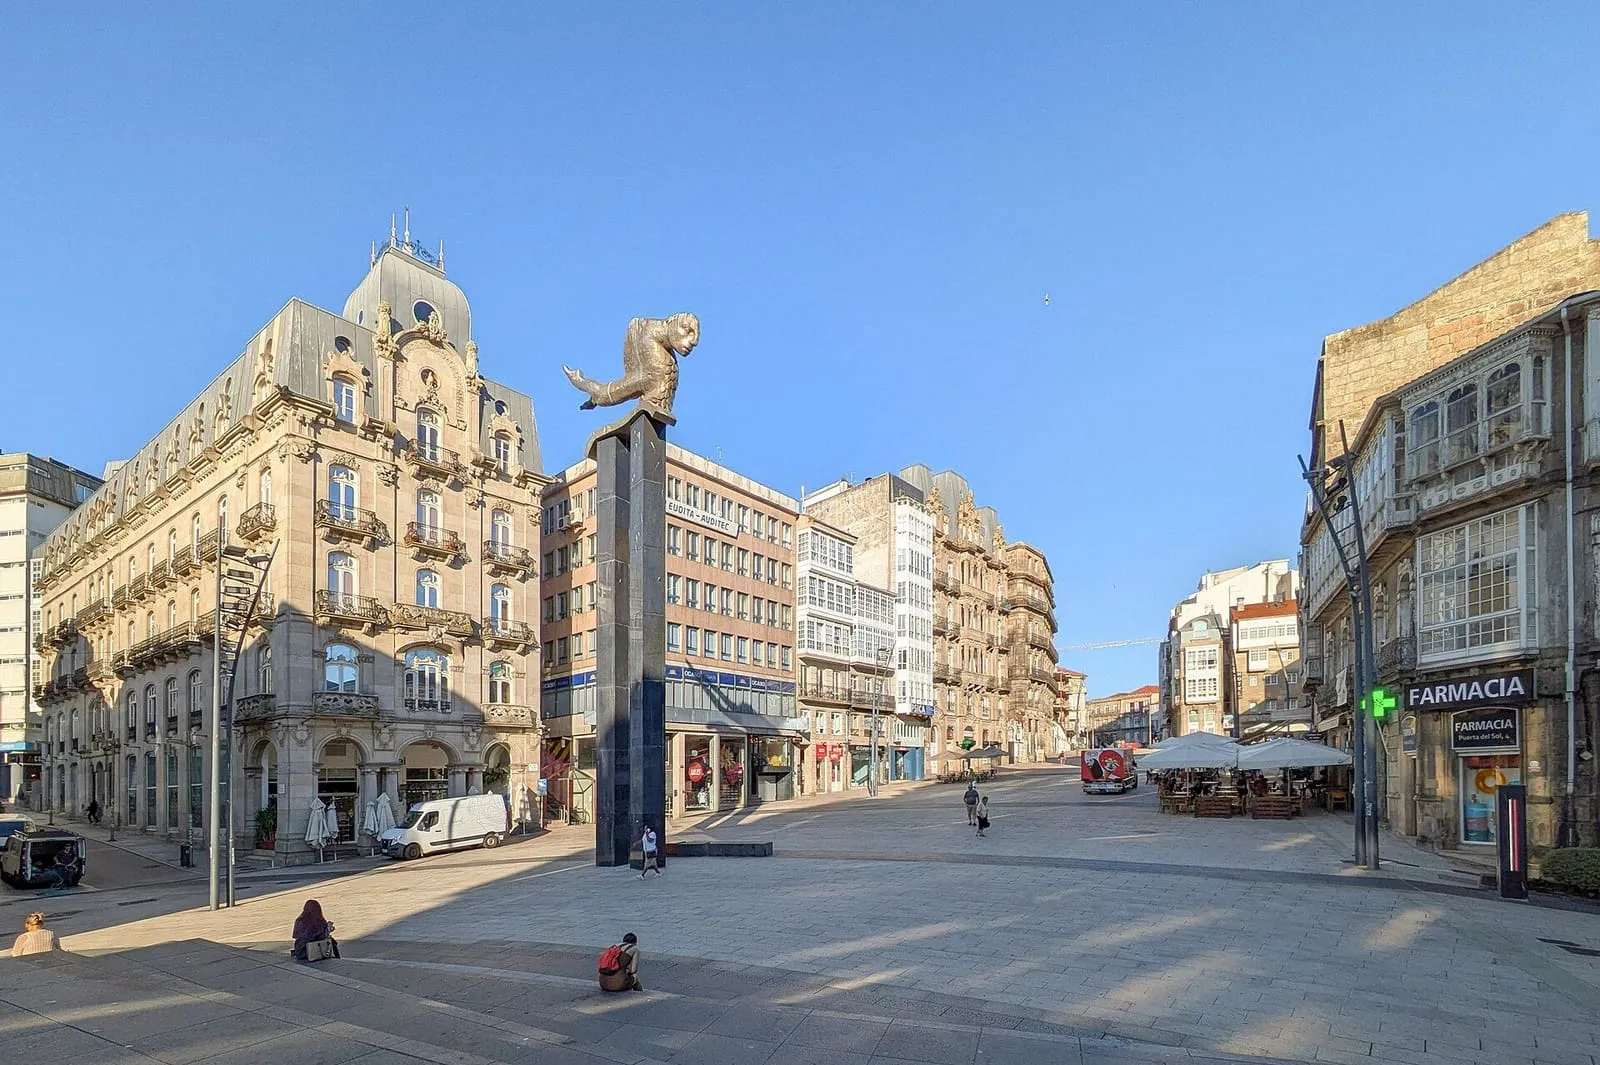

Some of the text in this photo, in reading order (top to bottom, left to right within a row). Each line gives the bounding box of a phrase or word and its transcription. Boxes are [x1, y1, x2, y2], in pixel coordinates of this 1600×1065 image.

[668, 502, 695, 518] EUDITA
[700, 514, 730, 531] AUDITEC
[1409, 676, 1525, 706] FARMACIA
[1455, 719, 1514, 732] FARMACIA
[1491, 732, 1504, 740] Sol,
